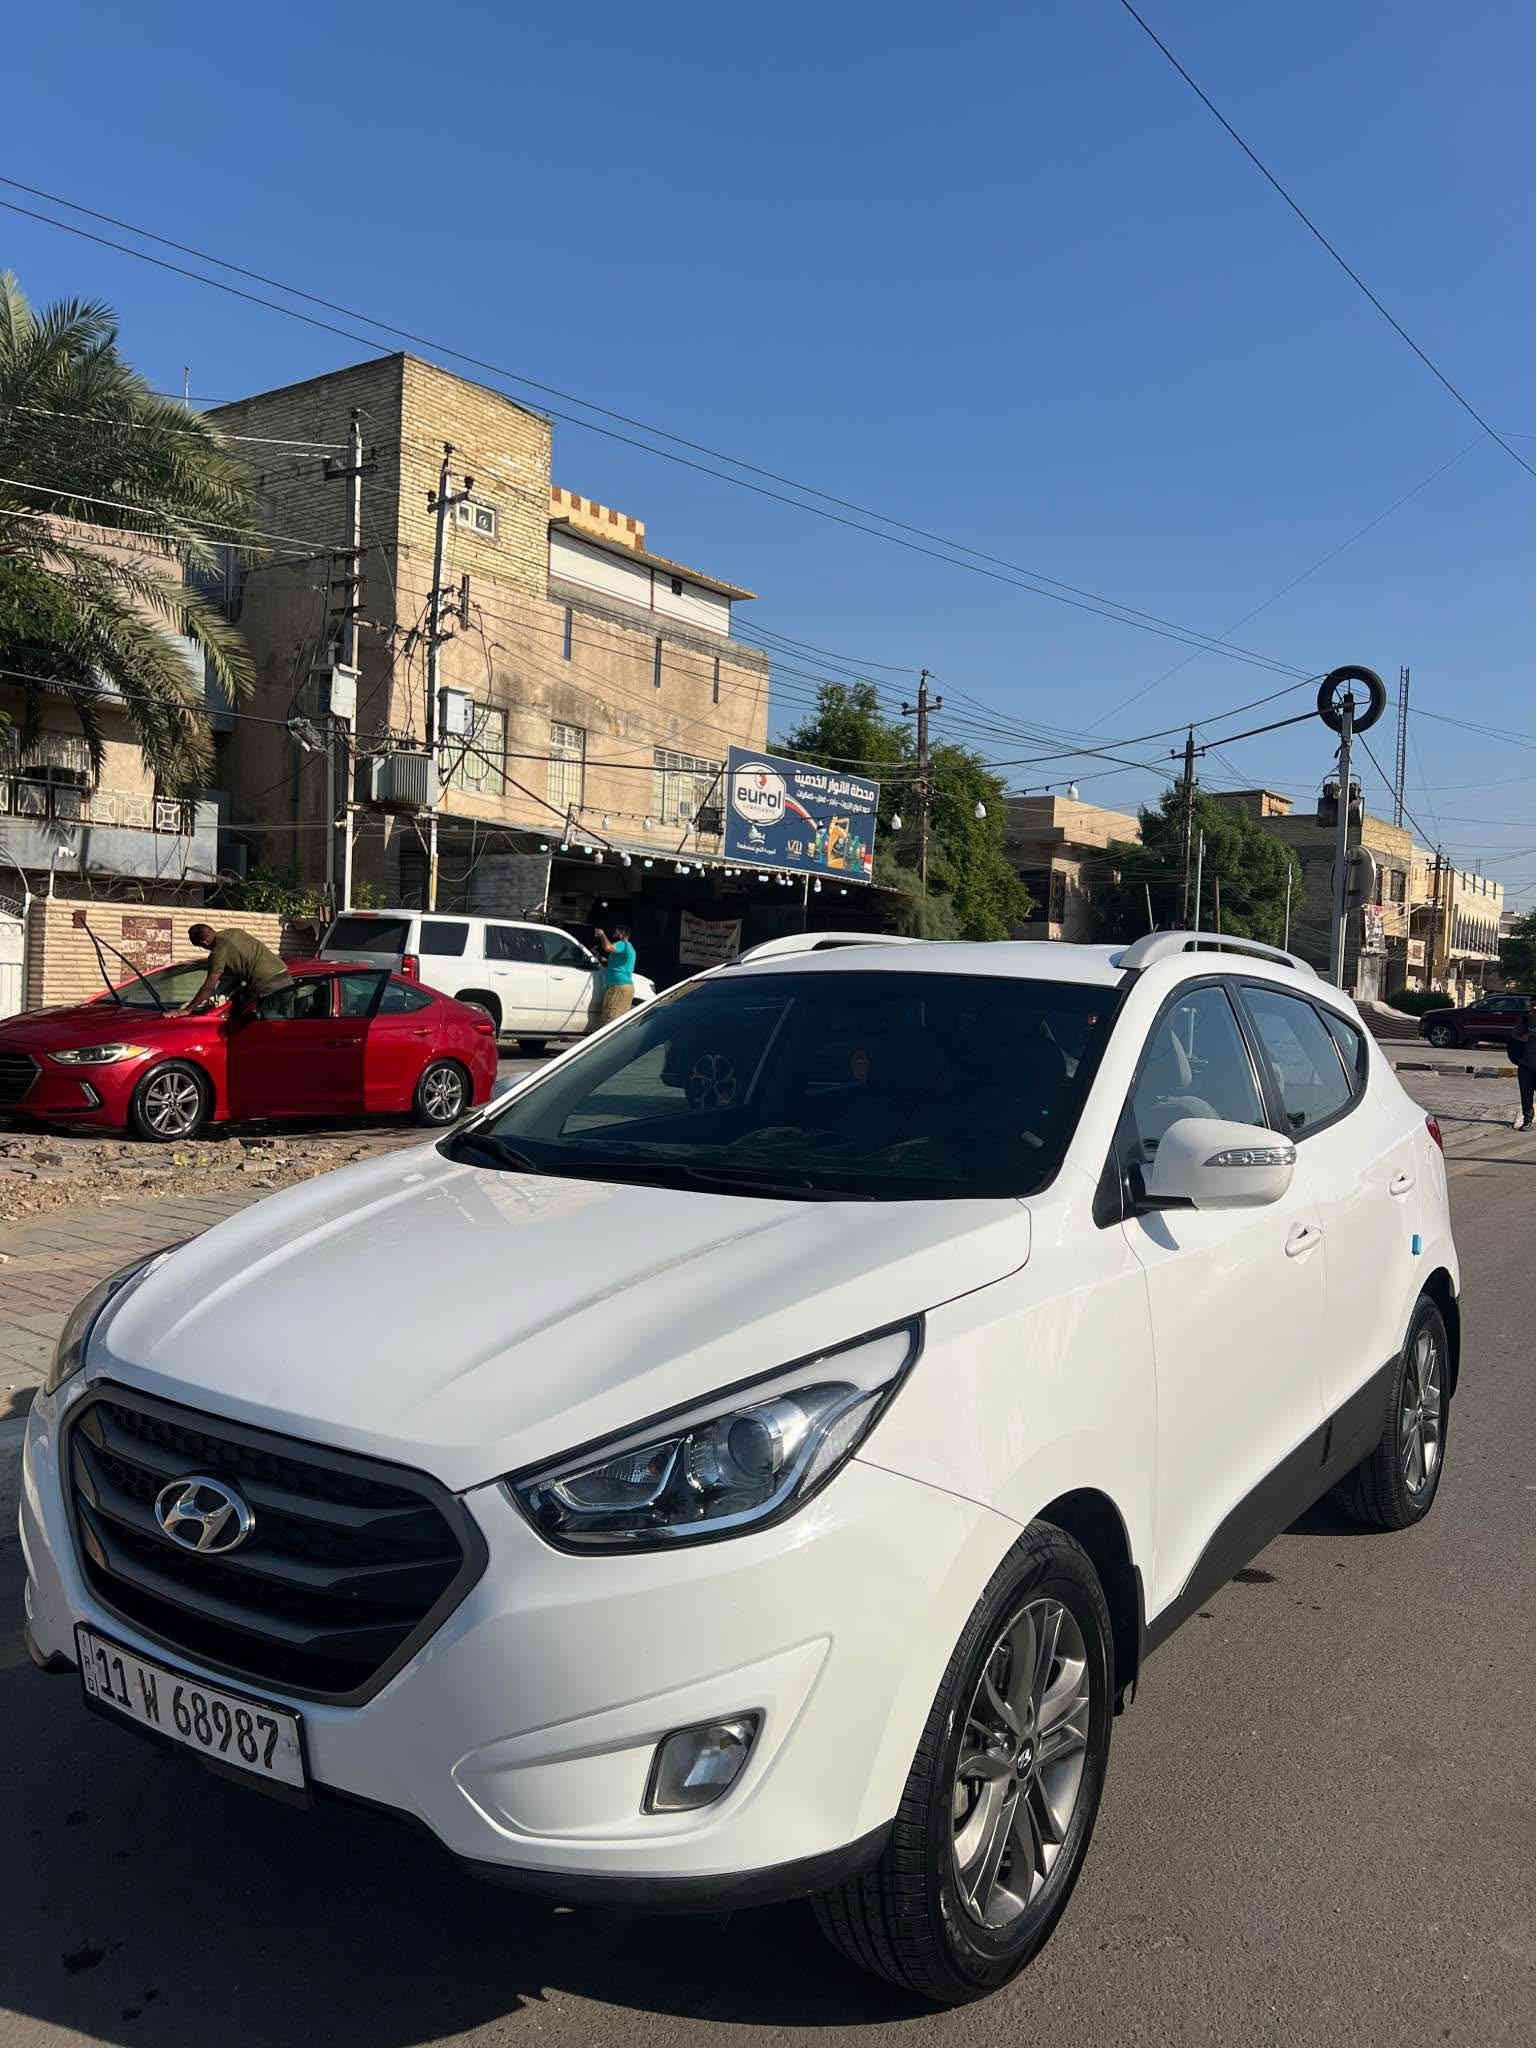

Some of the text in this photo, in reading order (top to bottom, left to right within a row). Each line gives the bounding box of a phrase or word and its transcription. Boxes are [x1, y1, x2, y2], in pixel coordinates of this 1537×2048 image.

[794, 769, 828, 789] الخدمية
[737, 787, 782, 809] eurol
[850, 784, 874, 801] محطة
[96, 1647, 132, 1708] 11
[172, 1686, 279, 1770] 68987
